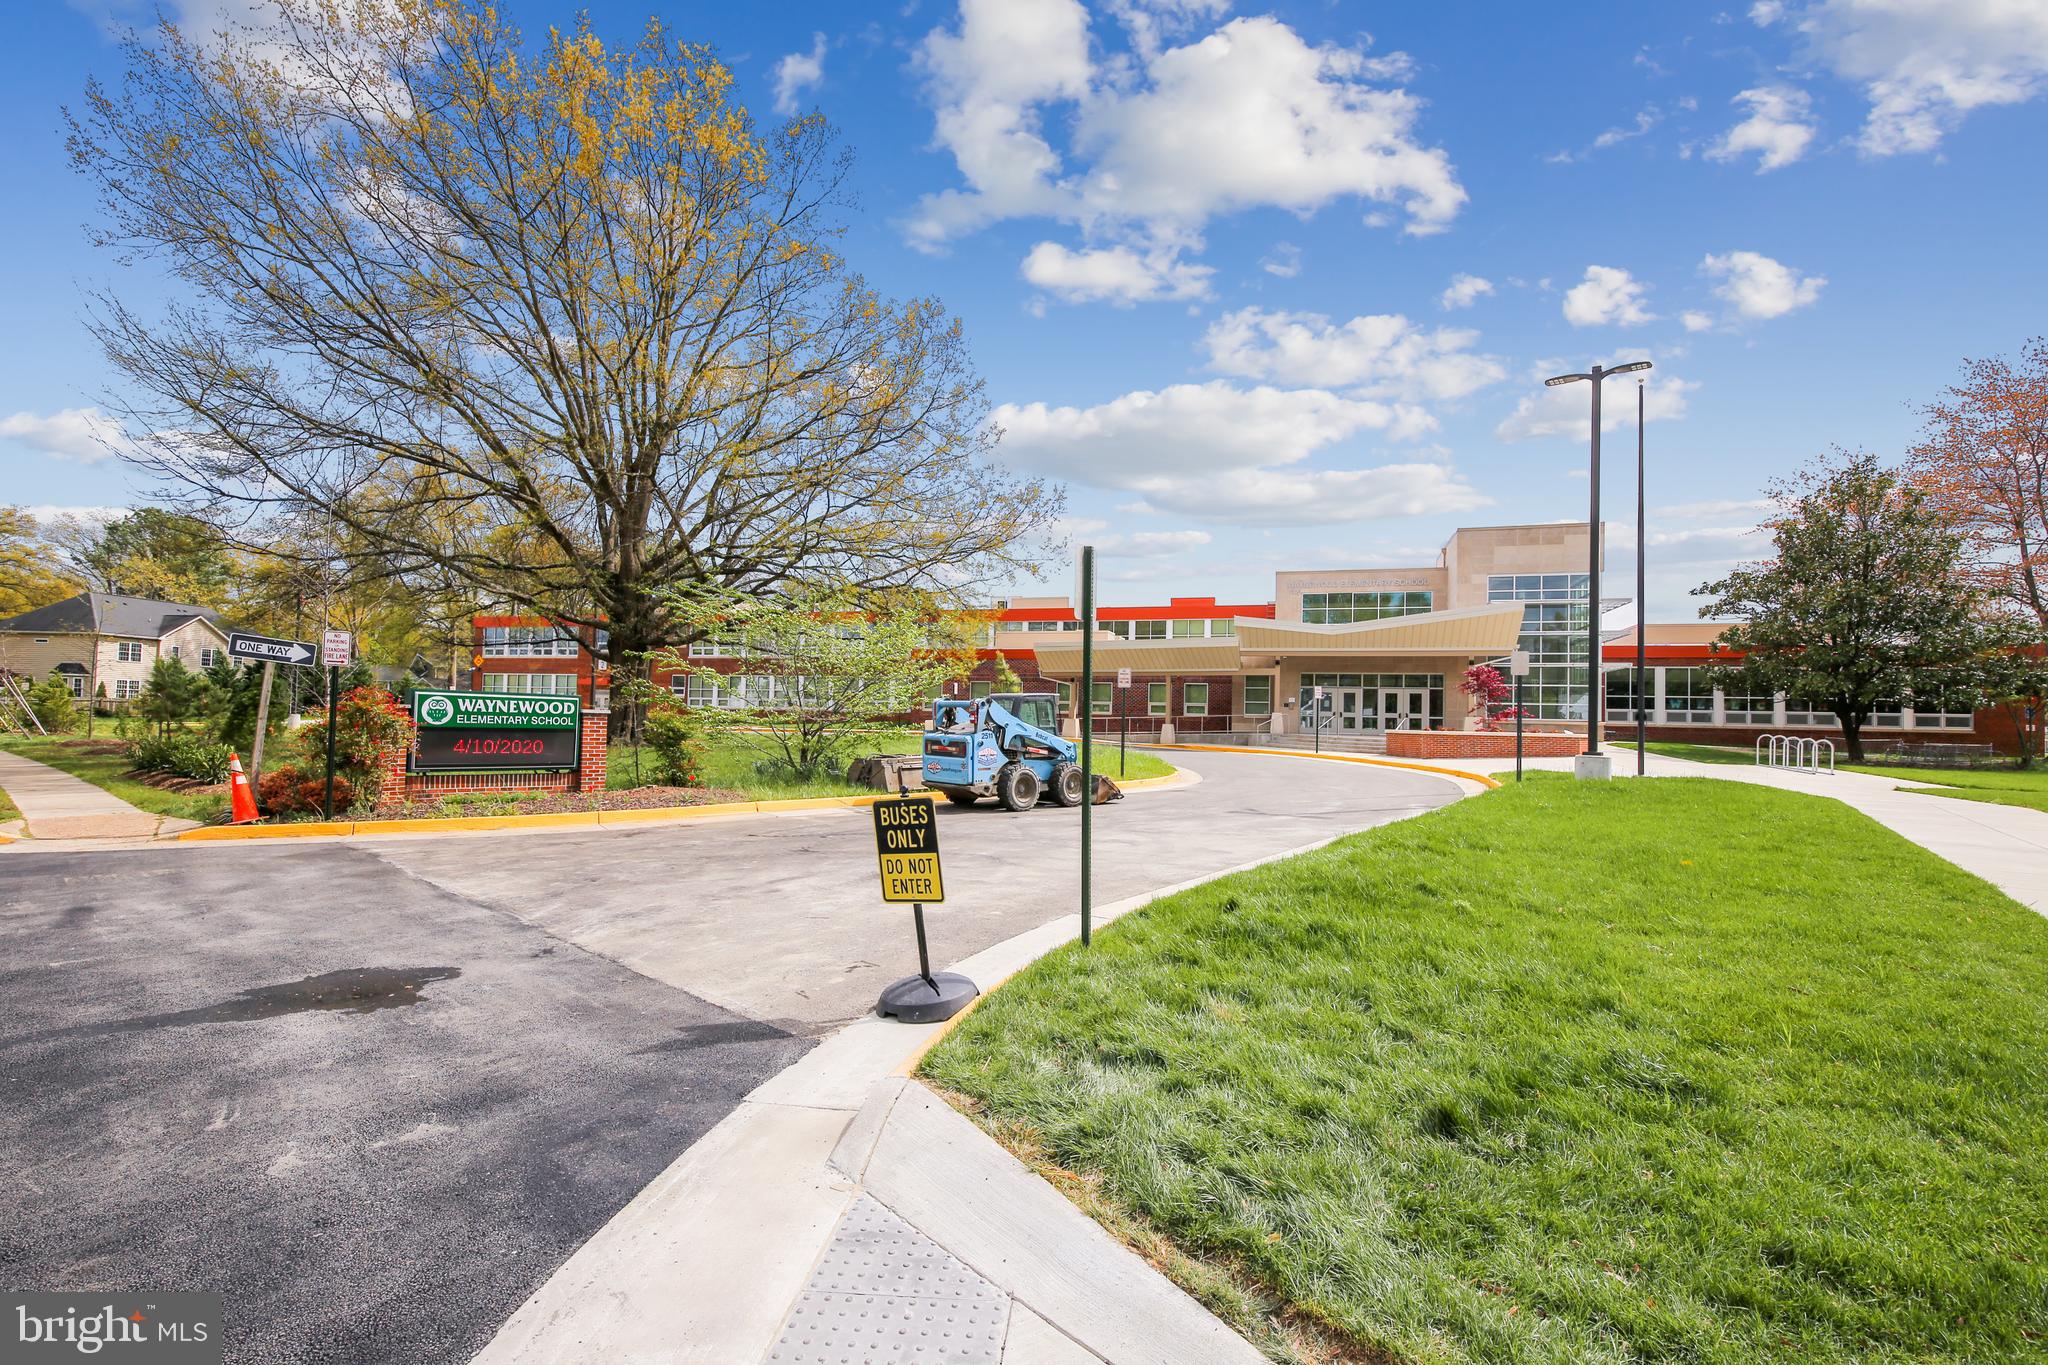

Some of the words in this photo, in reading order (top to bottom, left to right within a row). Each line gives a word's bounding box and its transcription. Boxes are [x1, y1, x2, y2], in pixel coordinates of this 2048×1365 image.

[239, 641, 263, 653] ONE
[267, 645, 291, 656] WAY
[457, 698, 575, 715] WAYNEWOOD
[457, 714, 529, 725] ELEMENTARY
[531, 716, 574, 726] SCHOOL
[981, 732, 993, 740] 2511
[1035, 731, 1049, 741] Bobcat
[453, 739, 544, 754] 4/10/2020
[880, 805, 928, 826] BUSES
[887, 829, 926, 848] ONLY
[886, 859, 903, 874] DO
[908, 858, 933, 874] NOT
[892, 878, 933, 894] ENTER
